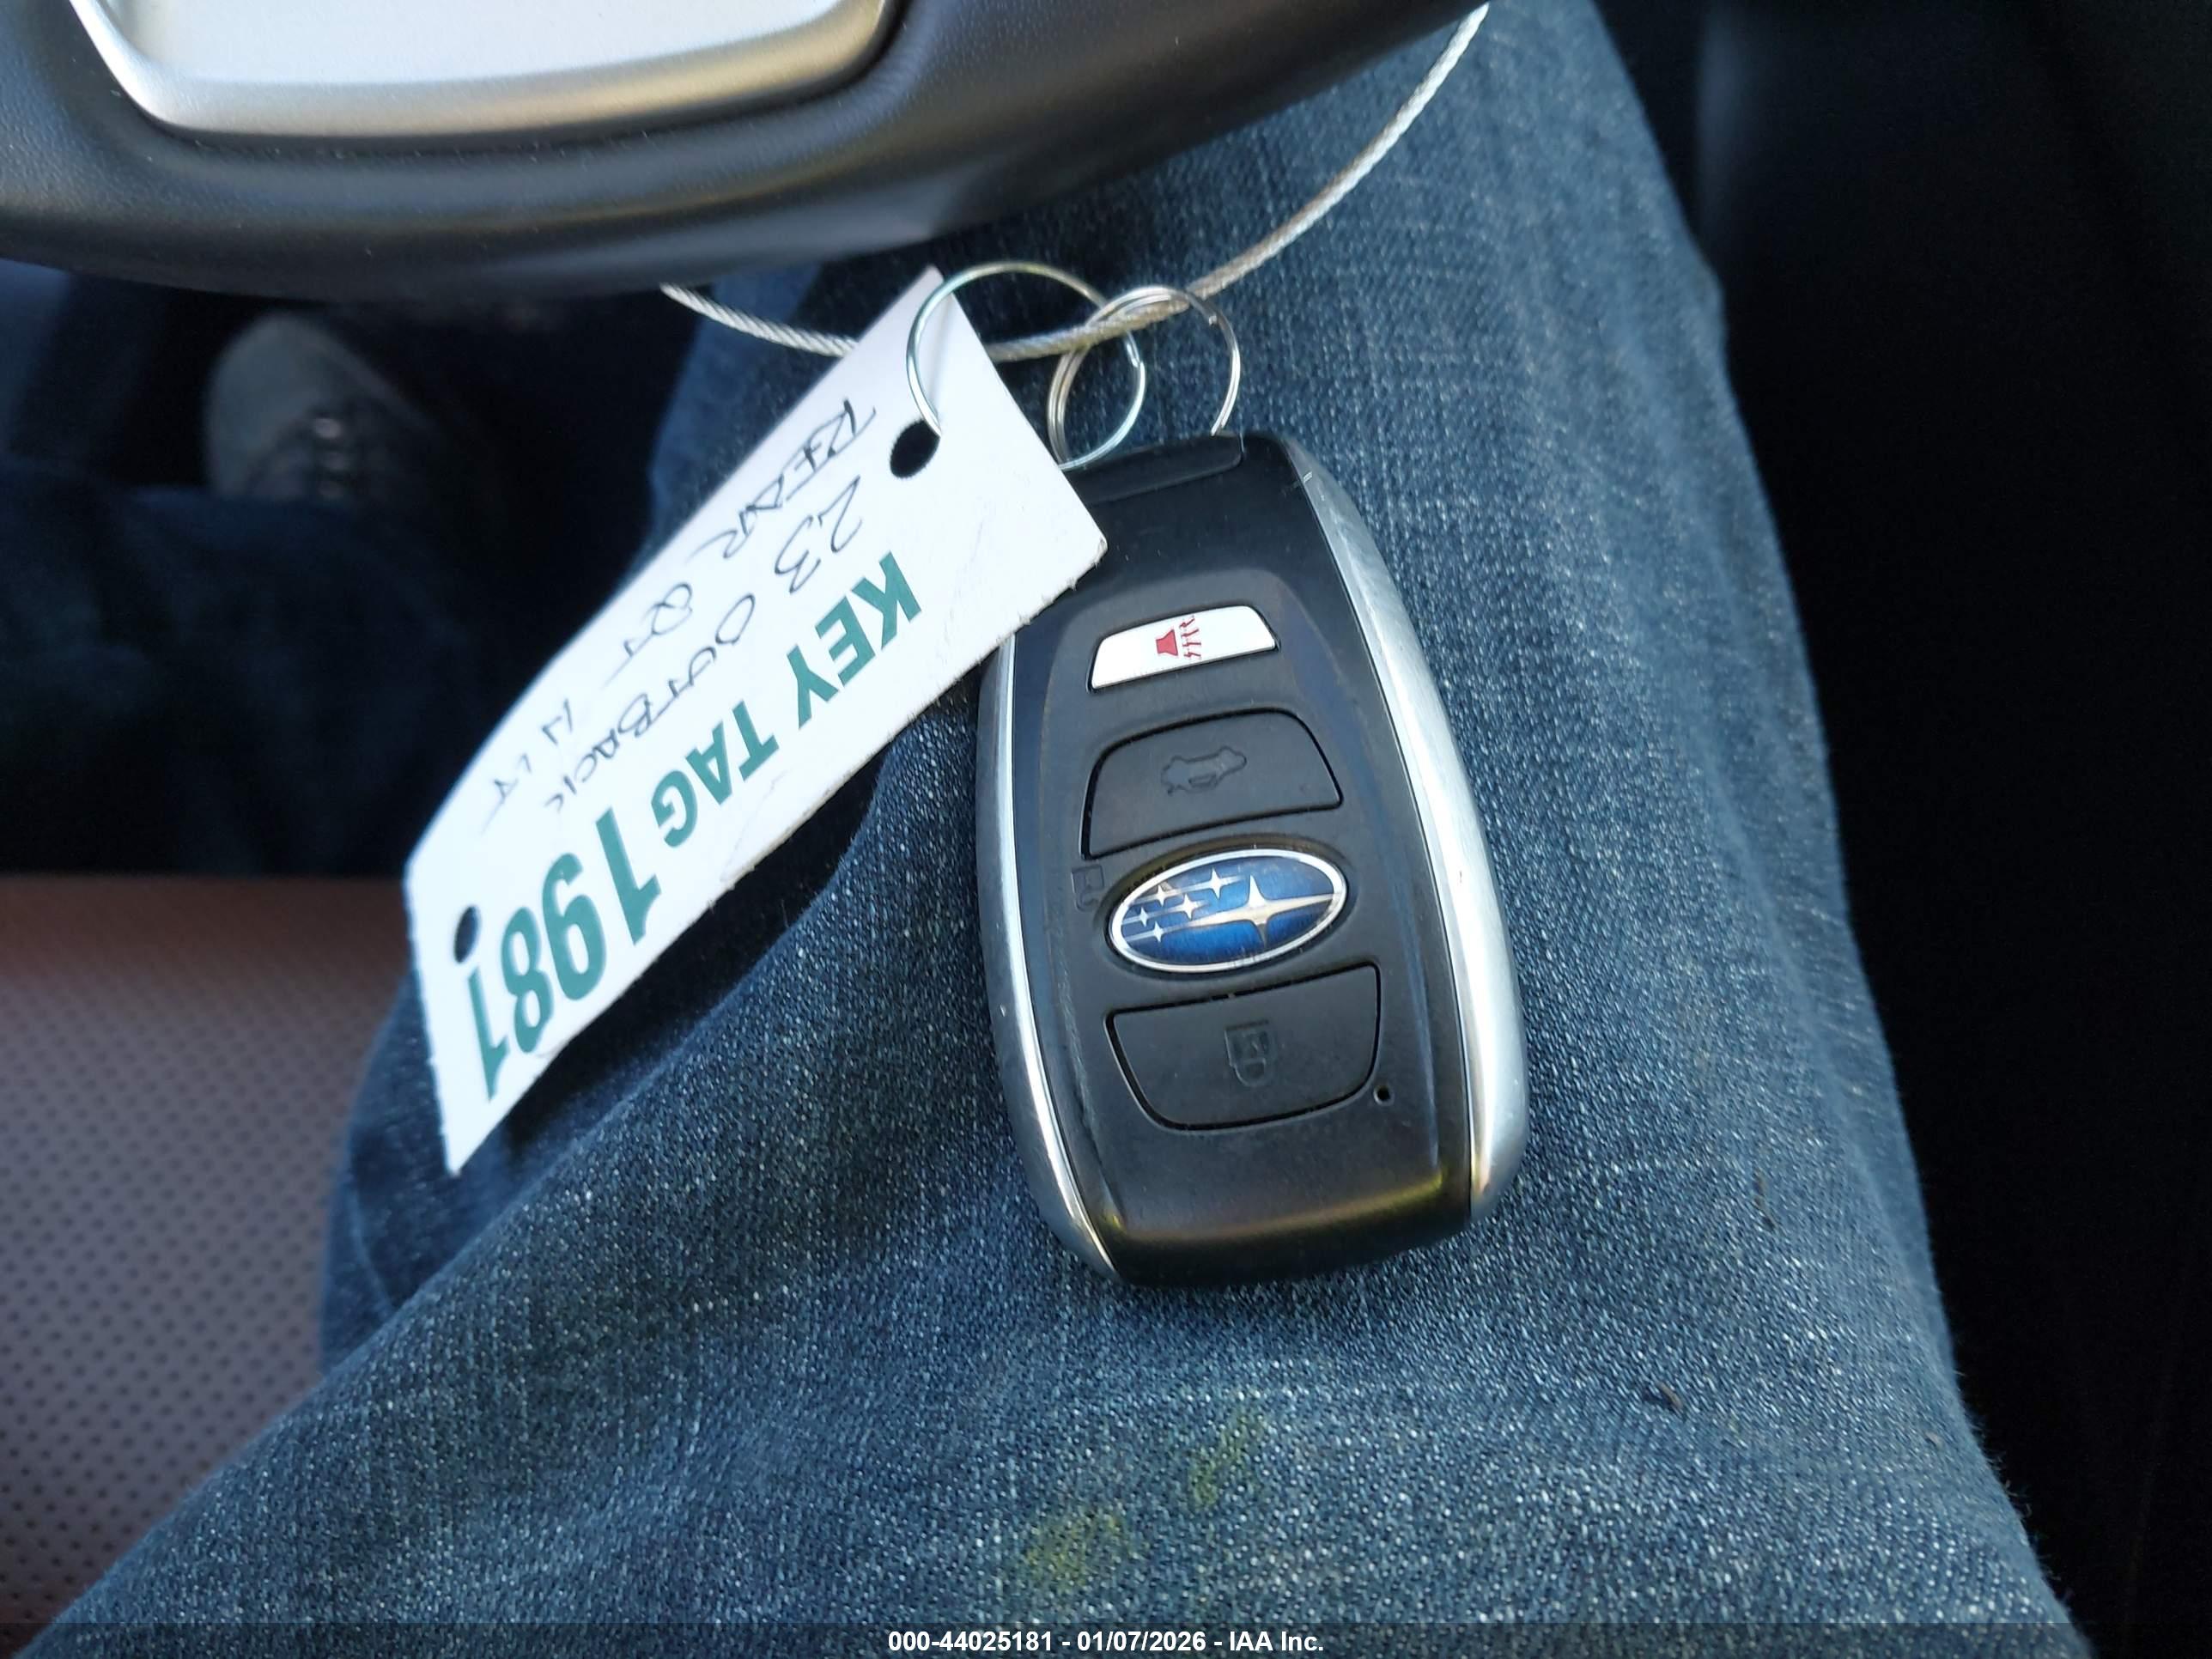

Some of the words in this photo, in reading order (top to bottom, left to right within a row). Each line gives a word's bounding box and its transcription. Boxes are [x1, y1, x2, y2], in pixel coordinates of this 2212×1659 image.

[687, 398, 876, 563] REAR
[775, 476, 862, 594] 23
[544, 593, 755, 814] OUTBACK
[601, 582, 693, 688] QT
[786, 550, 921, 730] KEY
[651, 700, 779, 848] TAG
[468, 805, 661, 1102] 1981
